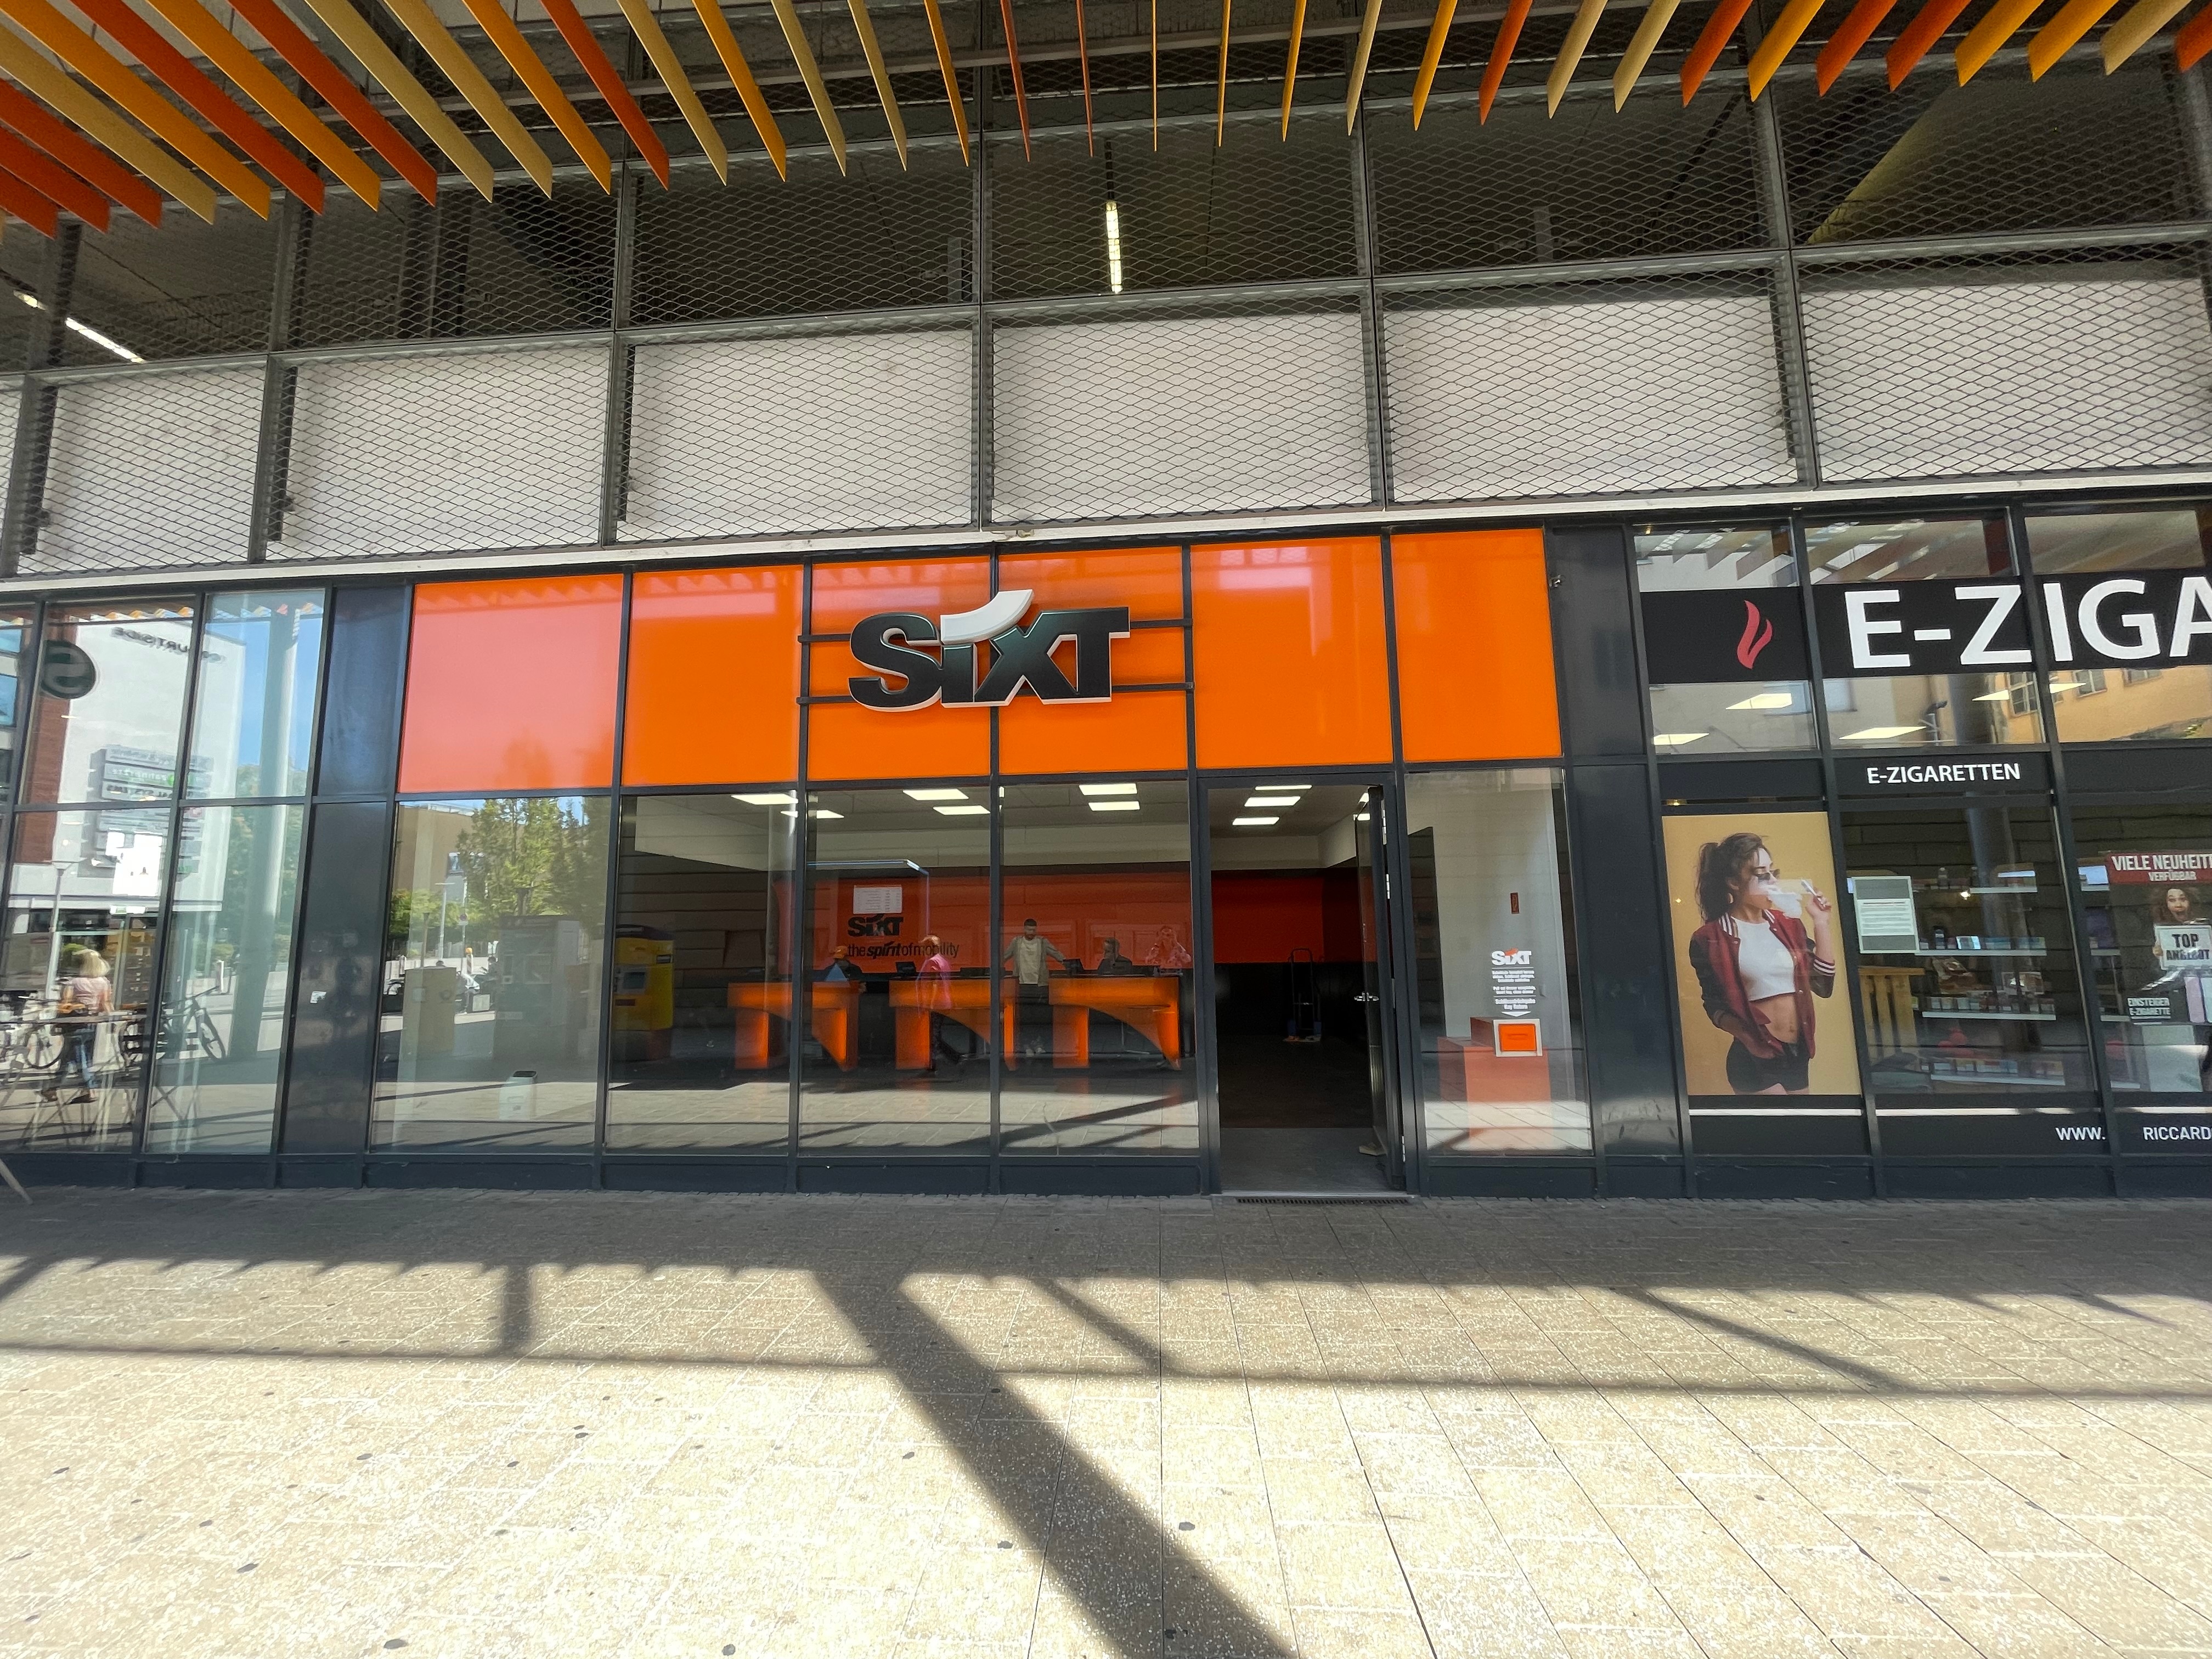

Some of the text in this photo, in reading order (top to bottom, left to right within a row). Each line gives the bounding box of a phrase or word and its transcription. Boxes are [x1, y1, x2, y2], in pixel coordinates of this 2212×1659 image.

[1866, 763, 2021, 783] E-ZIGARETTEN
[2111, 854, 2212, 871] VIELE NEUHEIT
[2171, 933, 2199, 947] TOP
[2055, 1126, 2212, 1141] WWW. RICCARD
